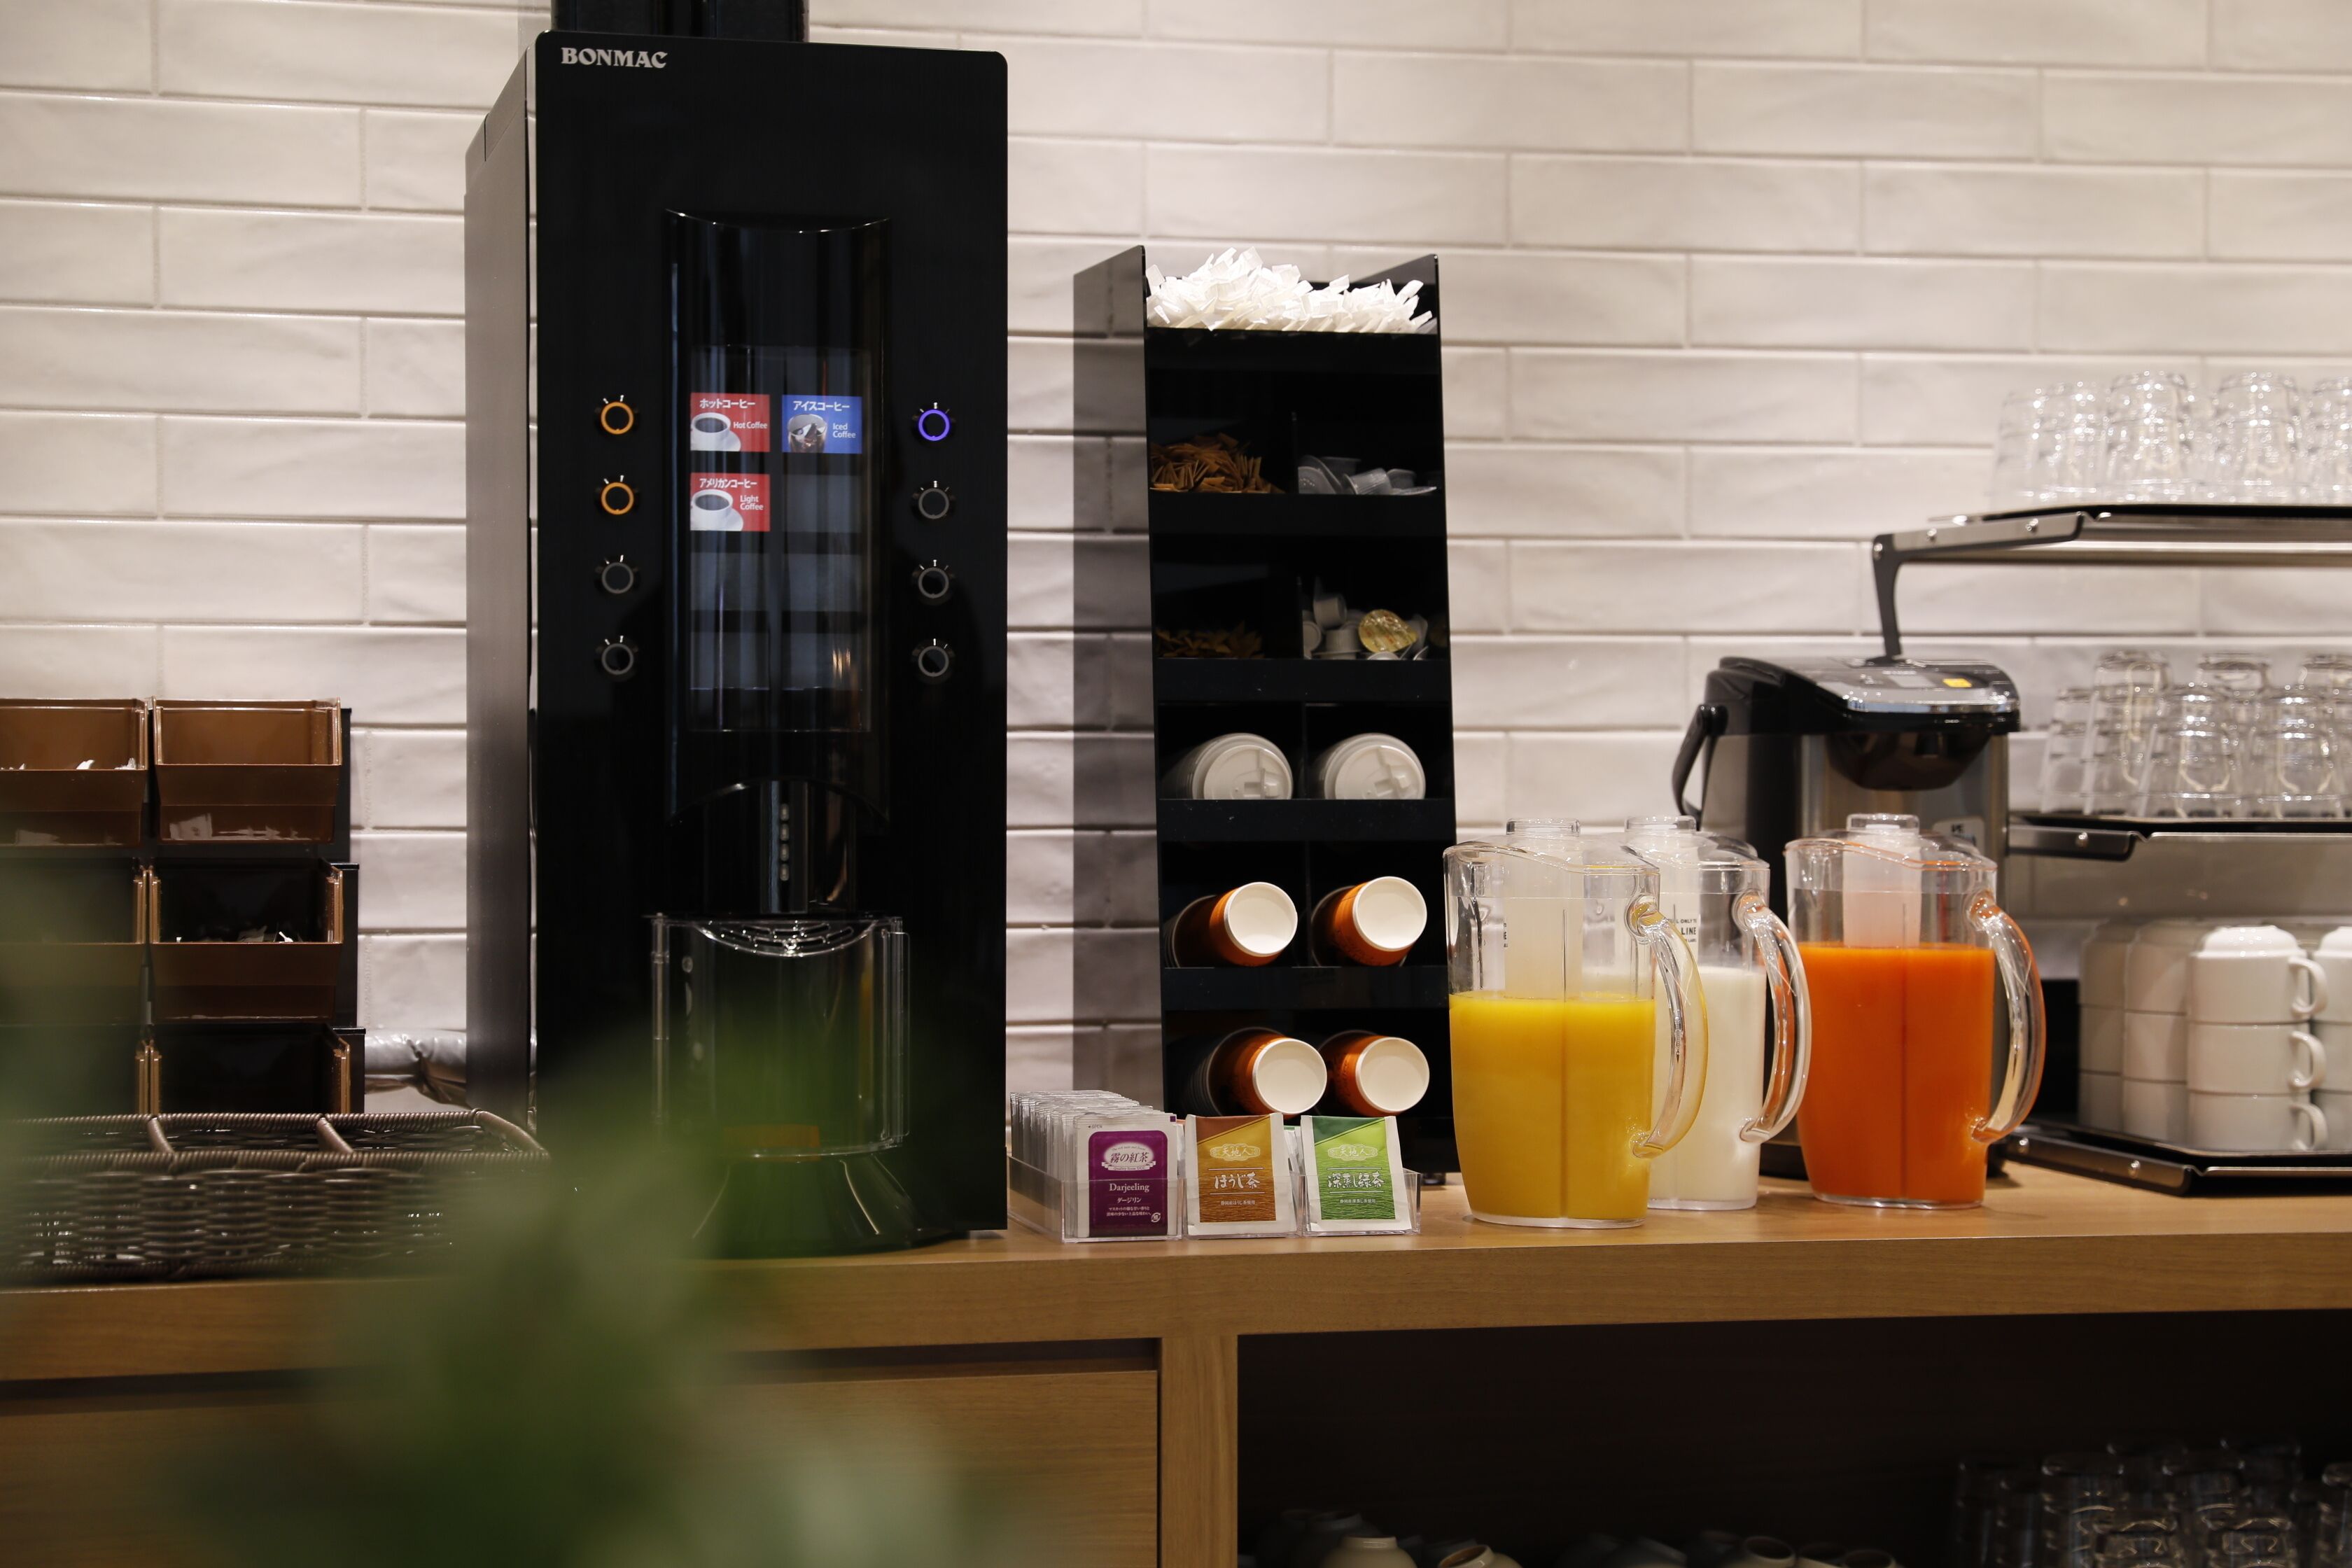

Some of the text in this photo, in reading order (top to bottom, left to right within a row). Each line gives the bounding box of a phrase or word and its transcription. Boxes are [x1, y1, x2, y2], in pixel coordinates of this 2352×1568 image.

[561, 47, 668, 69] BONMAC
[699, 398, 756, 409] ホットコーヒー
[793, 400, 850, 412] アイスコーヒー
[699, 478, 757, 489] アメリカンコーヒー
[740, 495, 759, 504] Light
[1110, 1152, 1149, 1163] 霧の紅茶
[1214, 1171, 1260, 1189] ほうじ茶
[1327, 1170, 1385, 1189] 深蒸し緑茶
[1109, 1182, 1150, 1194] Darjeeling
